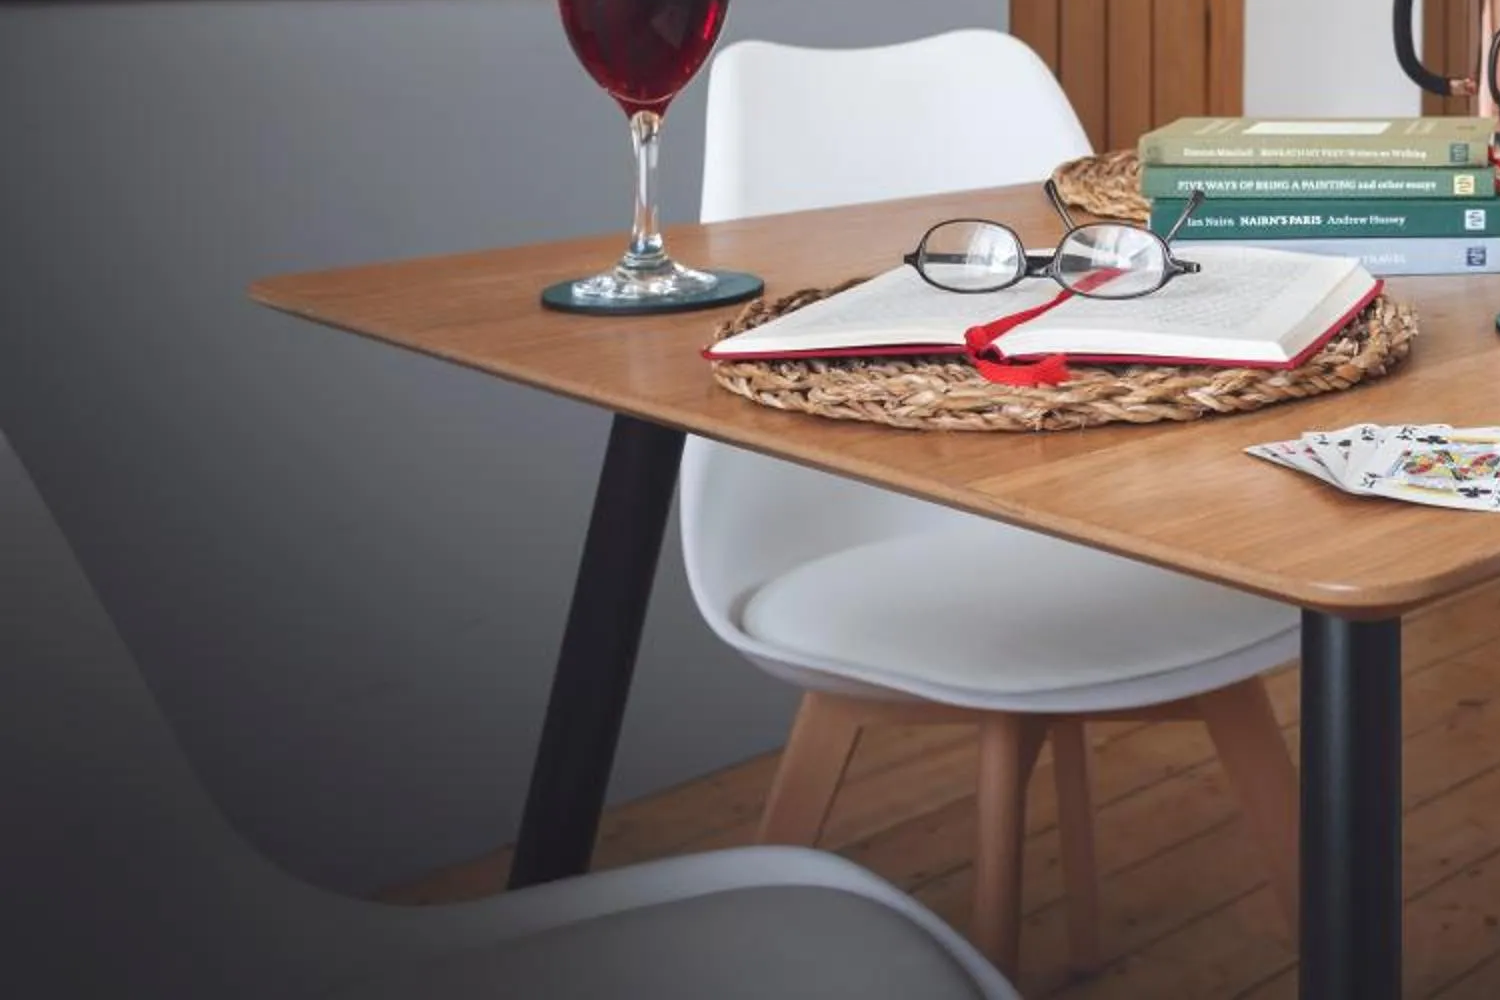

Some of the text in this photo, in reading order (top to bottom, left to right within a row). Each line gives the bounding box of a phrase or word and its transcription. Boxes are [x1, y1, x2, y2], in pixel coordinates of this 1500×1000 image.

[1205, 180, 1237, 191] WAYS
[1239, 180, 1255, 190] OF
[1255, 180, 1290, 191] BEING
[1291, 180, 1300, 190] A
[1301, 179, 1356, 191] PAINTING
[1357, 179, 1376, 190] and
[1377, 180, 1404, 190] other
[1186, 216, 1204, 227] Ian
[1205, 216, 1235, 227] Nairn
[1239, 215, 1288, 226] NAIRN'S
[1288, 215, 1323, 226] PARIS
[1326, 214, 1368, 225] Andrew
